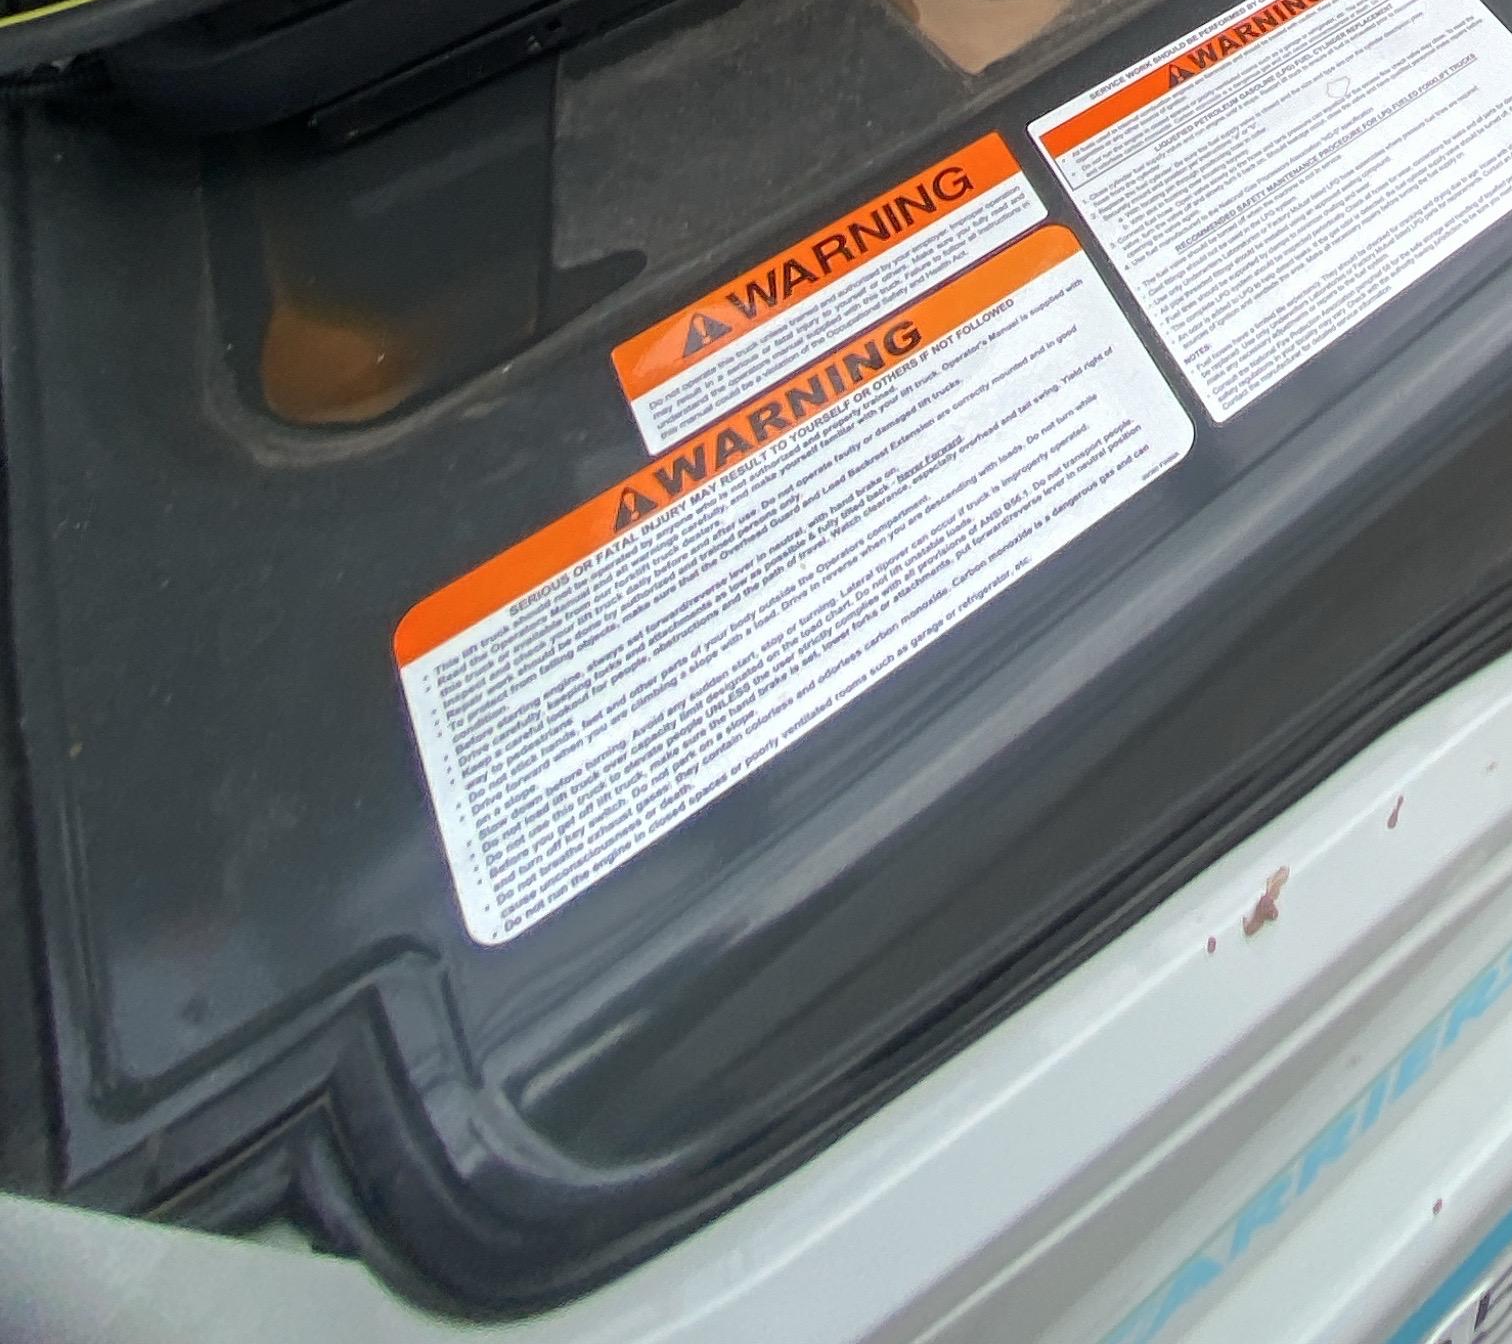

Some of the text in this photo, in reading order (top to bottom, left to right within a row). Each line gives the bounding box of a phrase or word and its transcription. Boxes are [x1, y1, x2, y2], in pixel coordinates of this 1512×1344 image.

[727, 161, 975, 319] WARNING
[508, 297, 1016, 618] SERIOUS OR FATAL INJURY MAY RESULT TO YOURSELF OR OTHERS IF NOT FOLLOWED
[655, 314, 925, 496] WARNING
